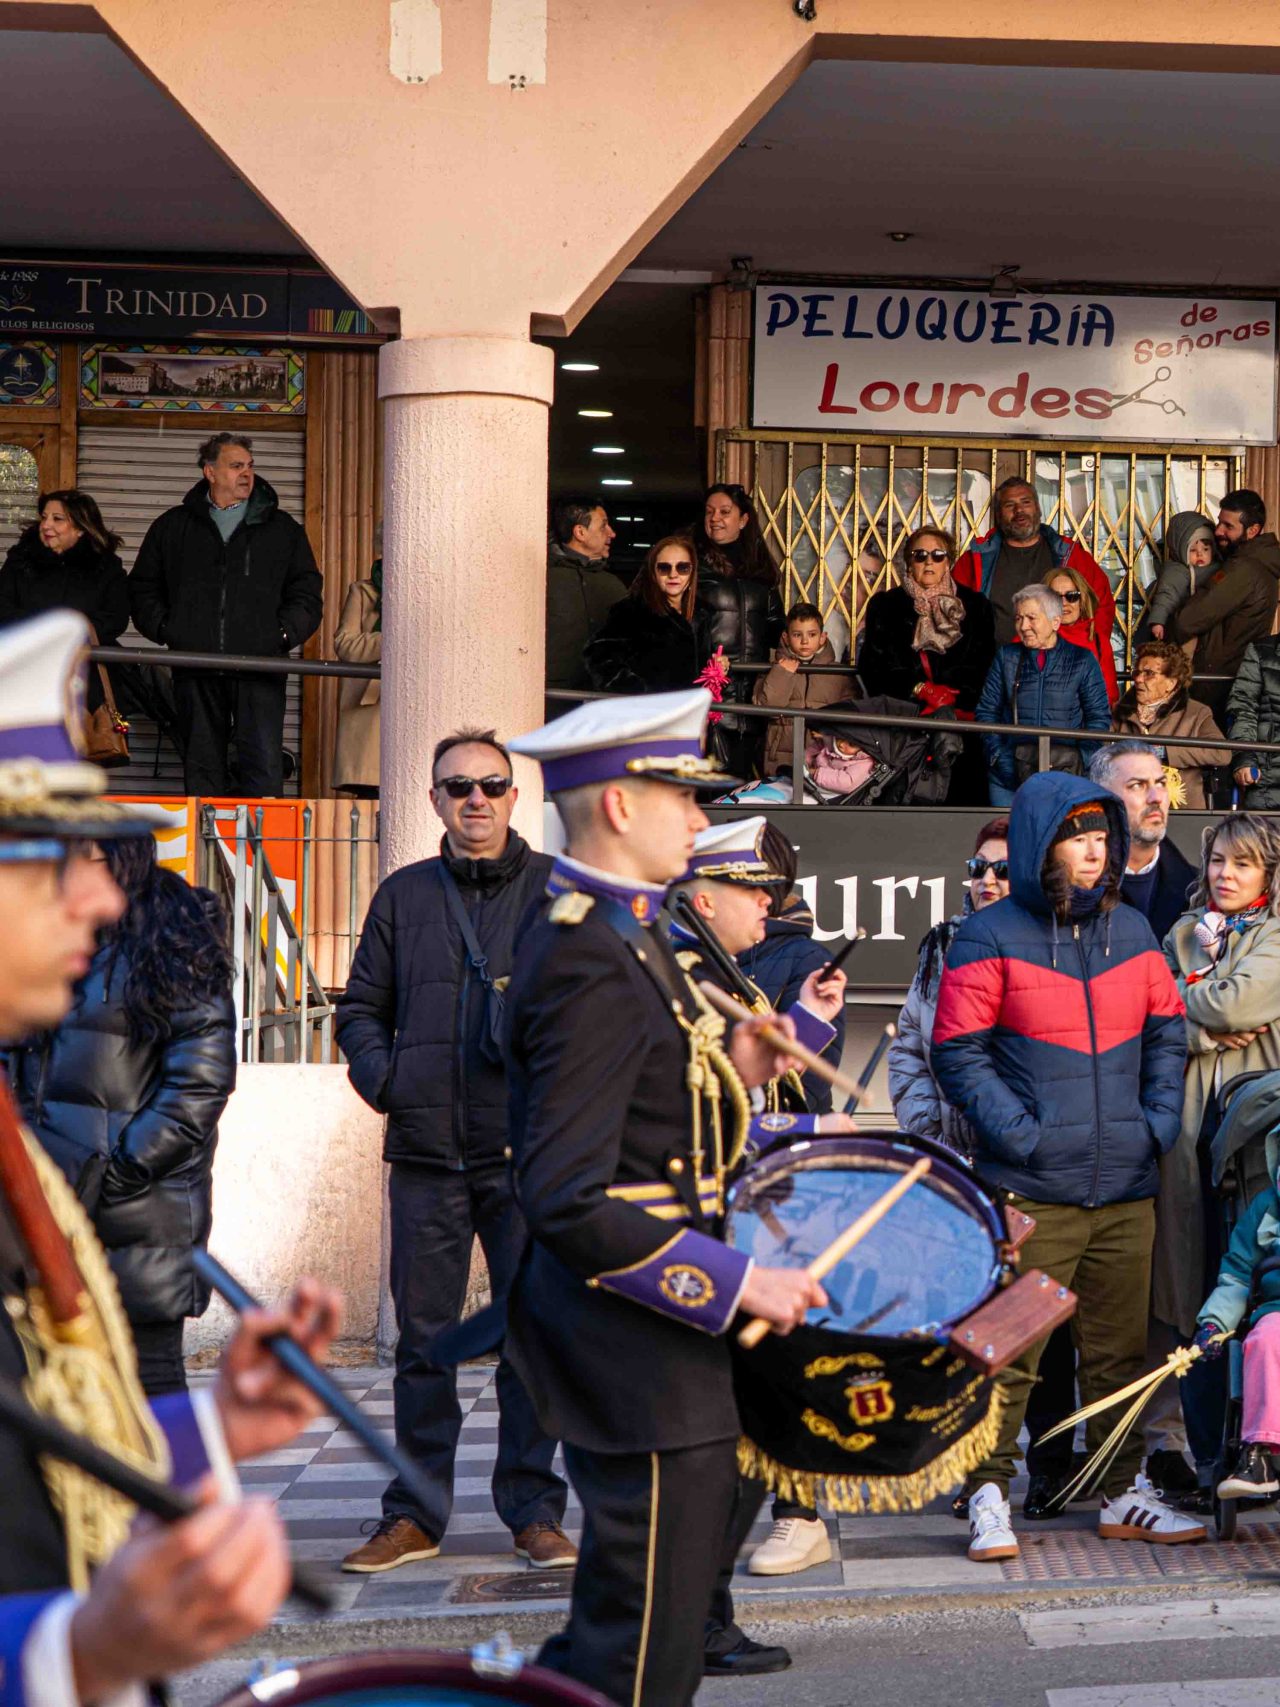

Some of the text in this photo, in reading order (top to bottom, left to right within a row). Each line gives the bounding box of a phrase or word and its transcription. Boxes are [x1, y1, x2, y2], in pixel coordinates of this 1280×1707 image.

[12, 271, 39, 281] 1988
[0, 320, 95, 330] ULOS RELIGIOSOS
[766, 293, 1115, 347] PELUQUERÍA
[1180, 303, 1218, 327] de
[1134, 320, 1271, 364] Señoras
[817, 362, 1113, 420] Lourdes
